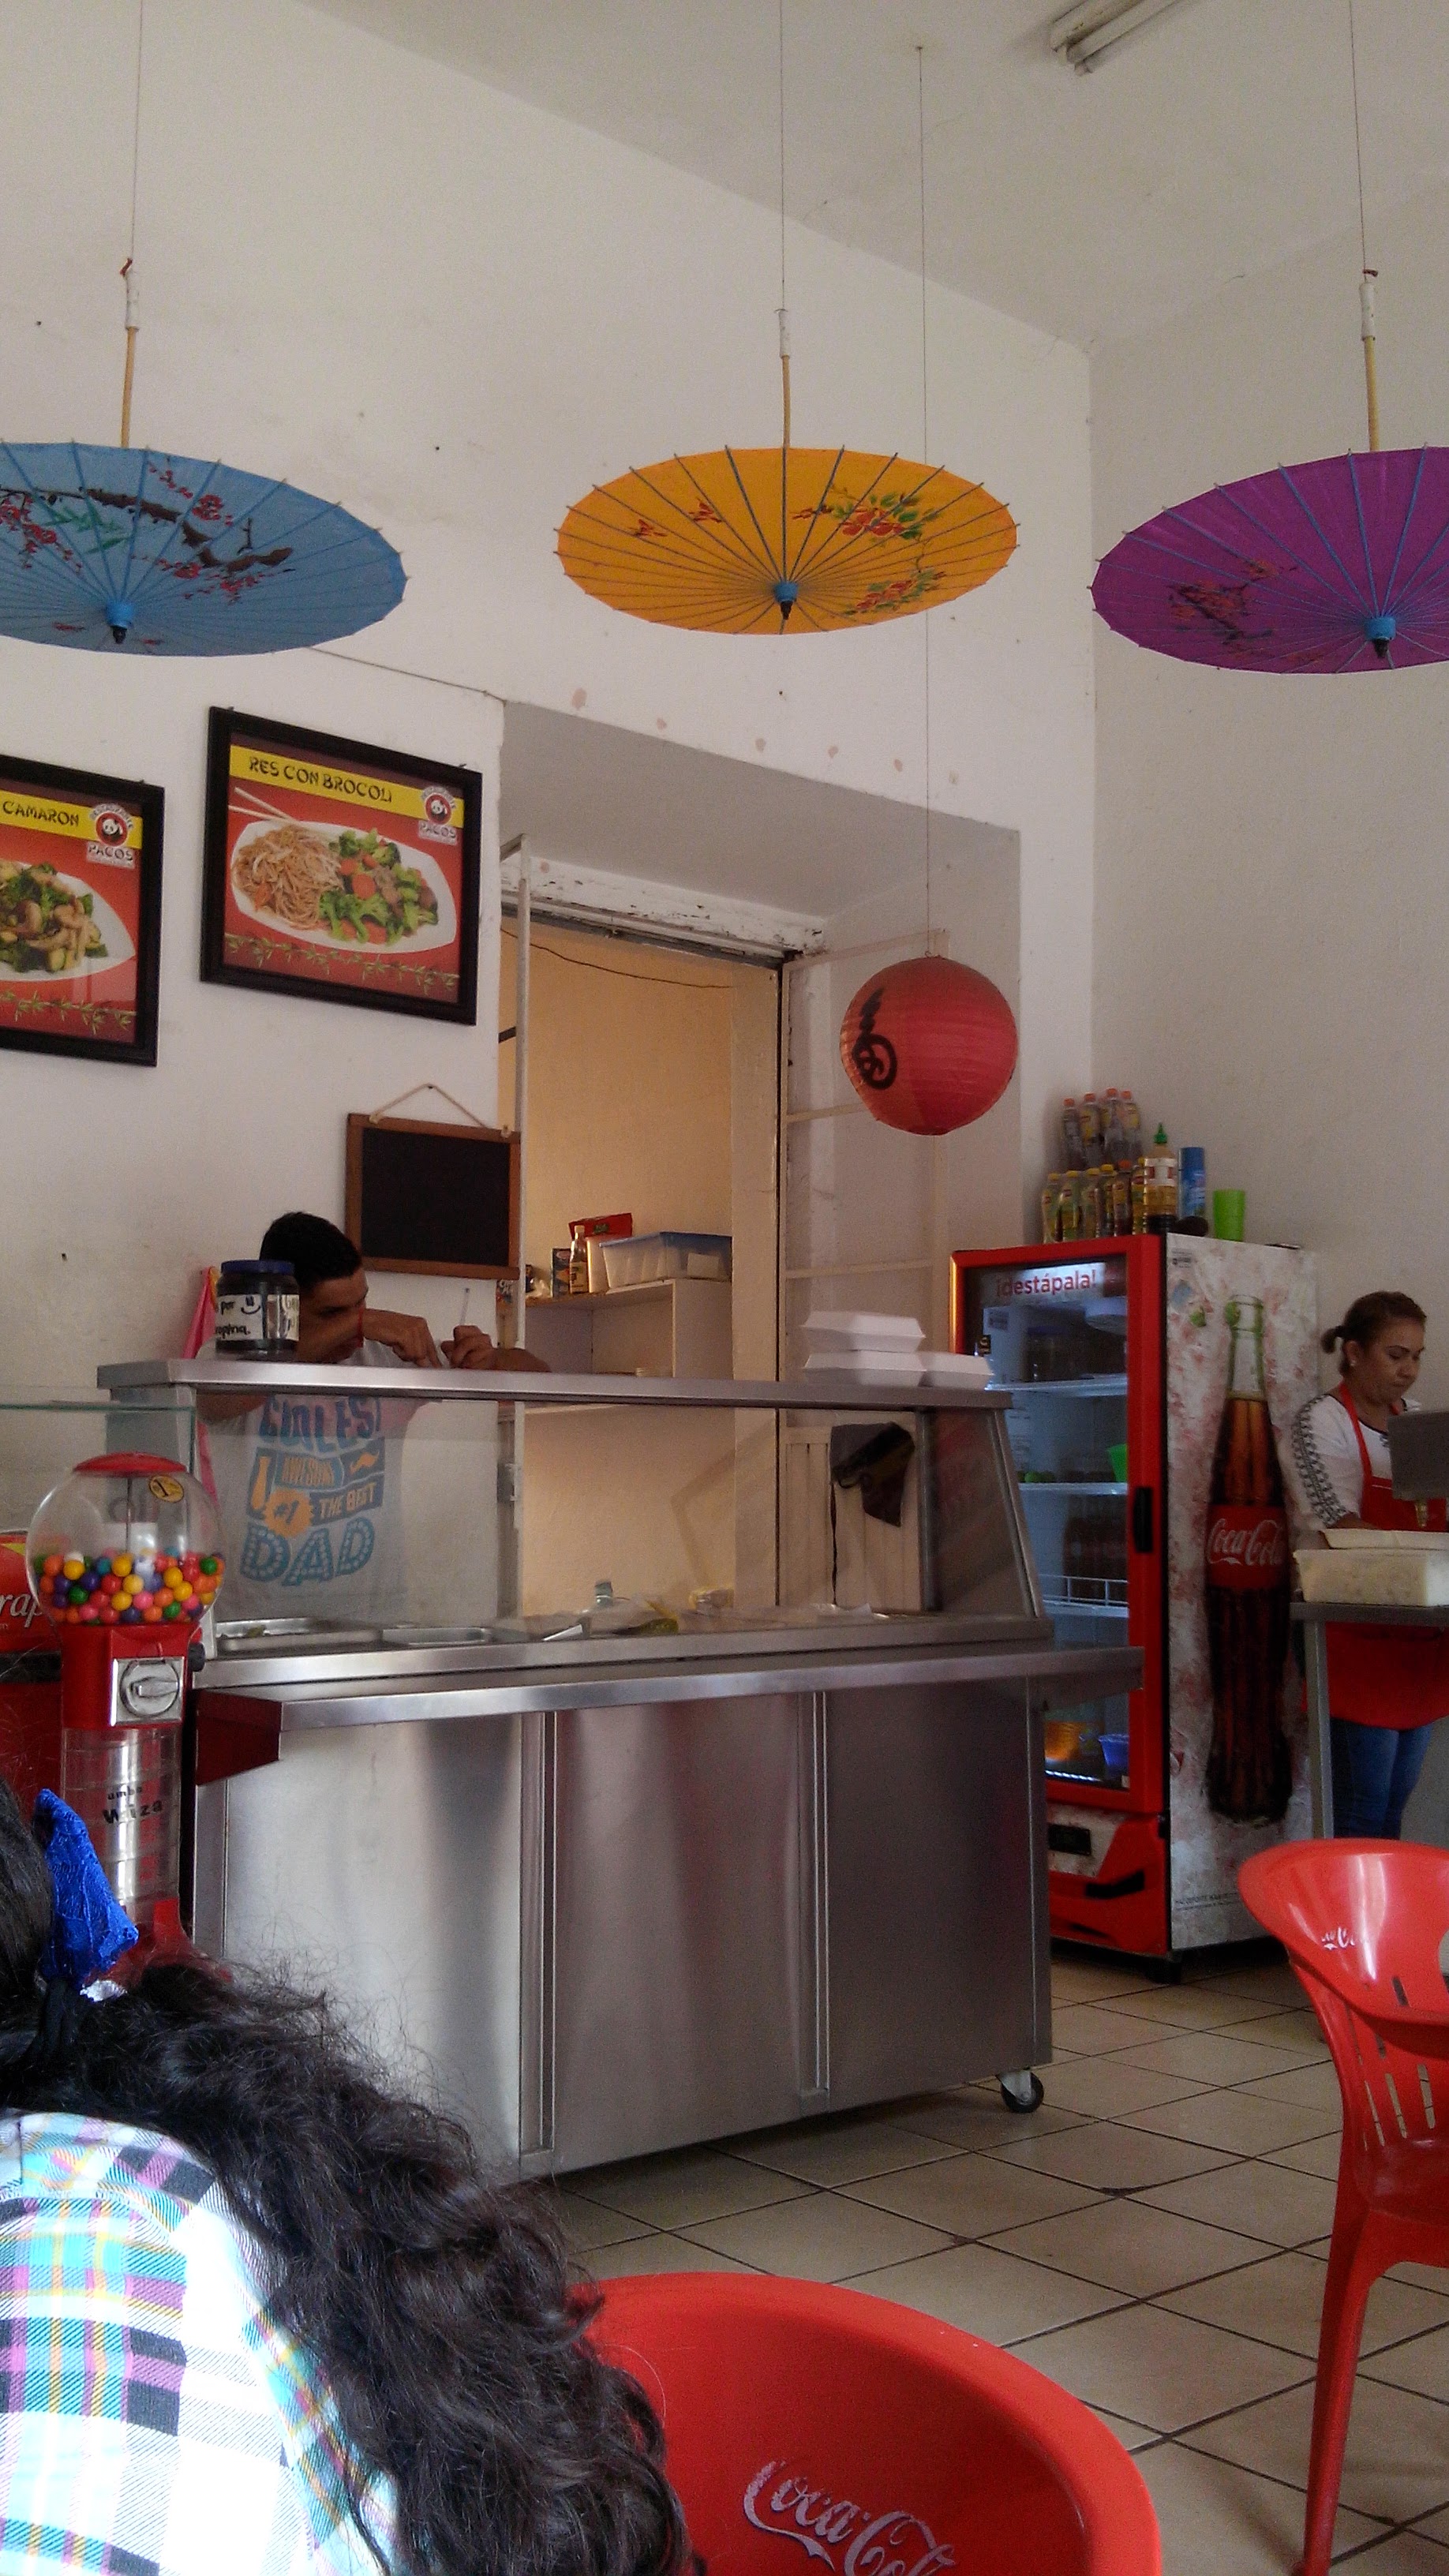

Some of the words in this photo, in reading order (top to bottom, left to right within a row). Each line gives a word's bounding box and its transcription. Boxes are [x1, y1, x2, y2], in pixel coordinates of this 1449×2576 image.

[249, 756, 279, 777] RES
[283, 766, 319, 786] CON
[323, 773, 392, 803] BROCOLI
[2, 800, 79, 827] CAMARON
[88, 844, 133, 862] PACOS
[240, 1516, 375, 1586] DAD
[743, 2459, 955, 2576] Coca-C
